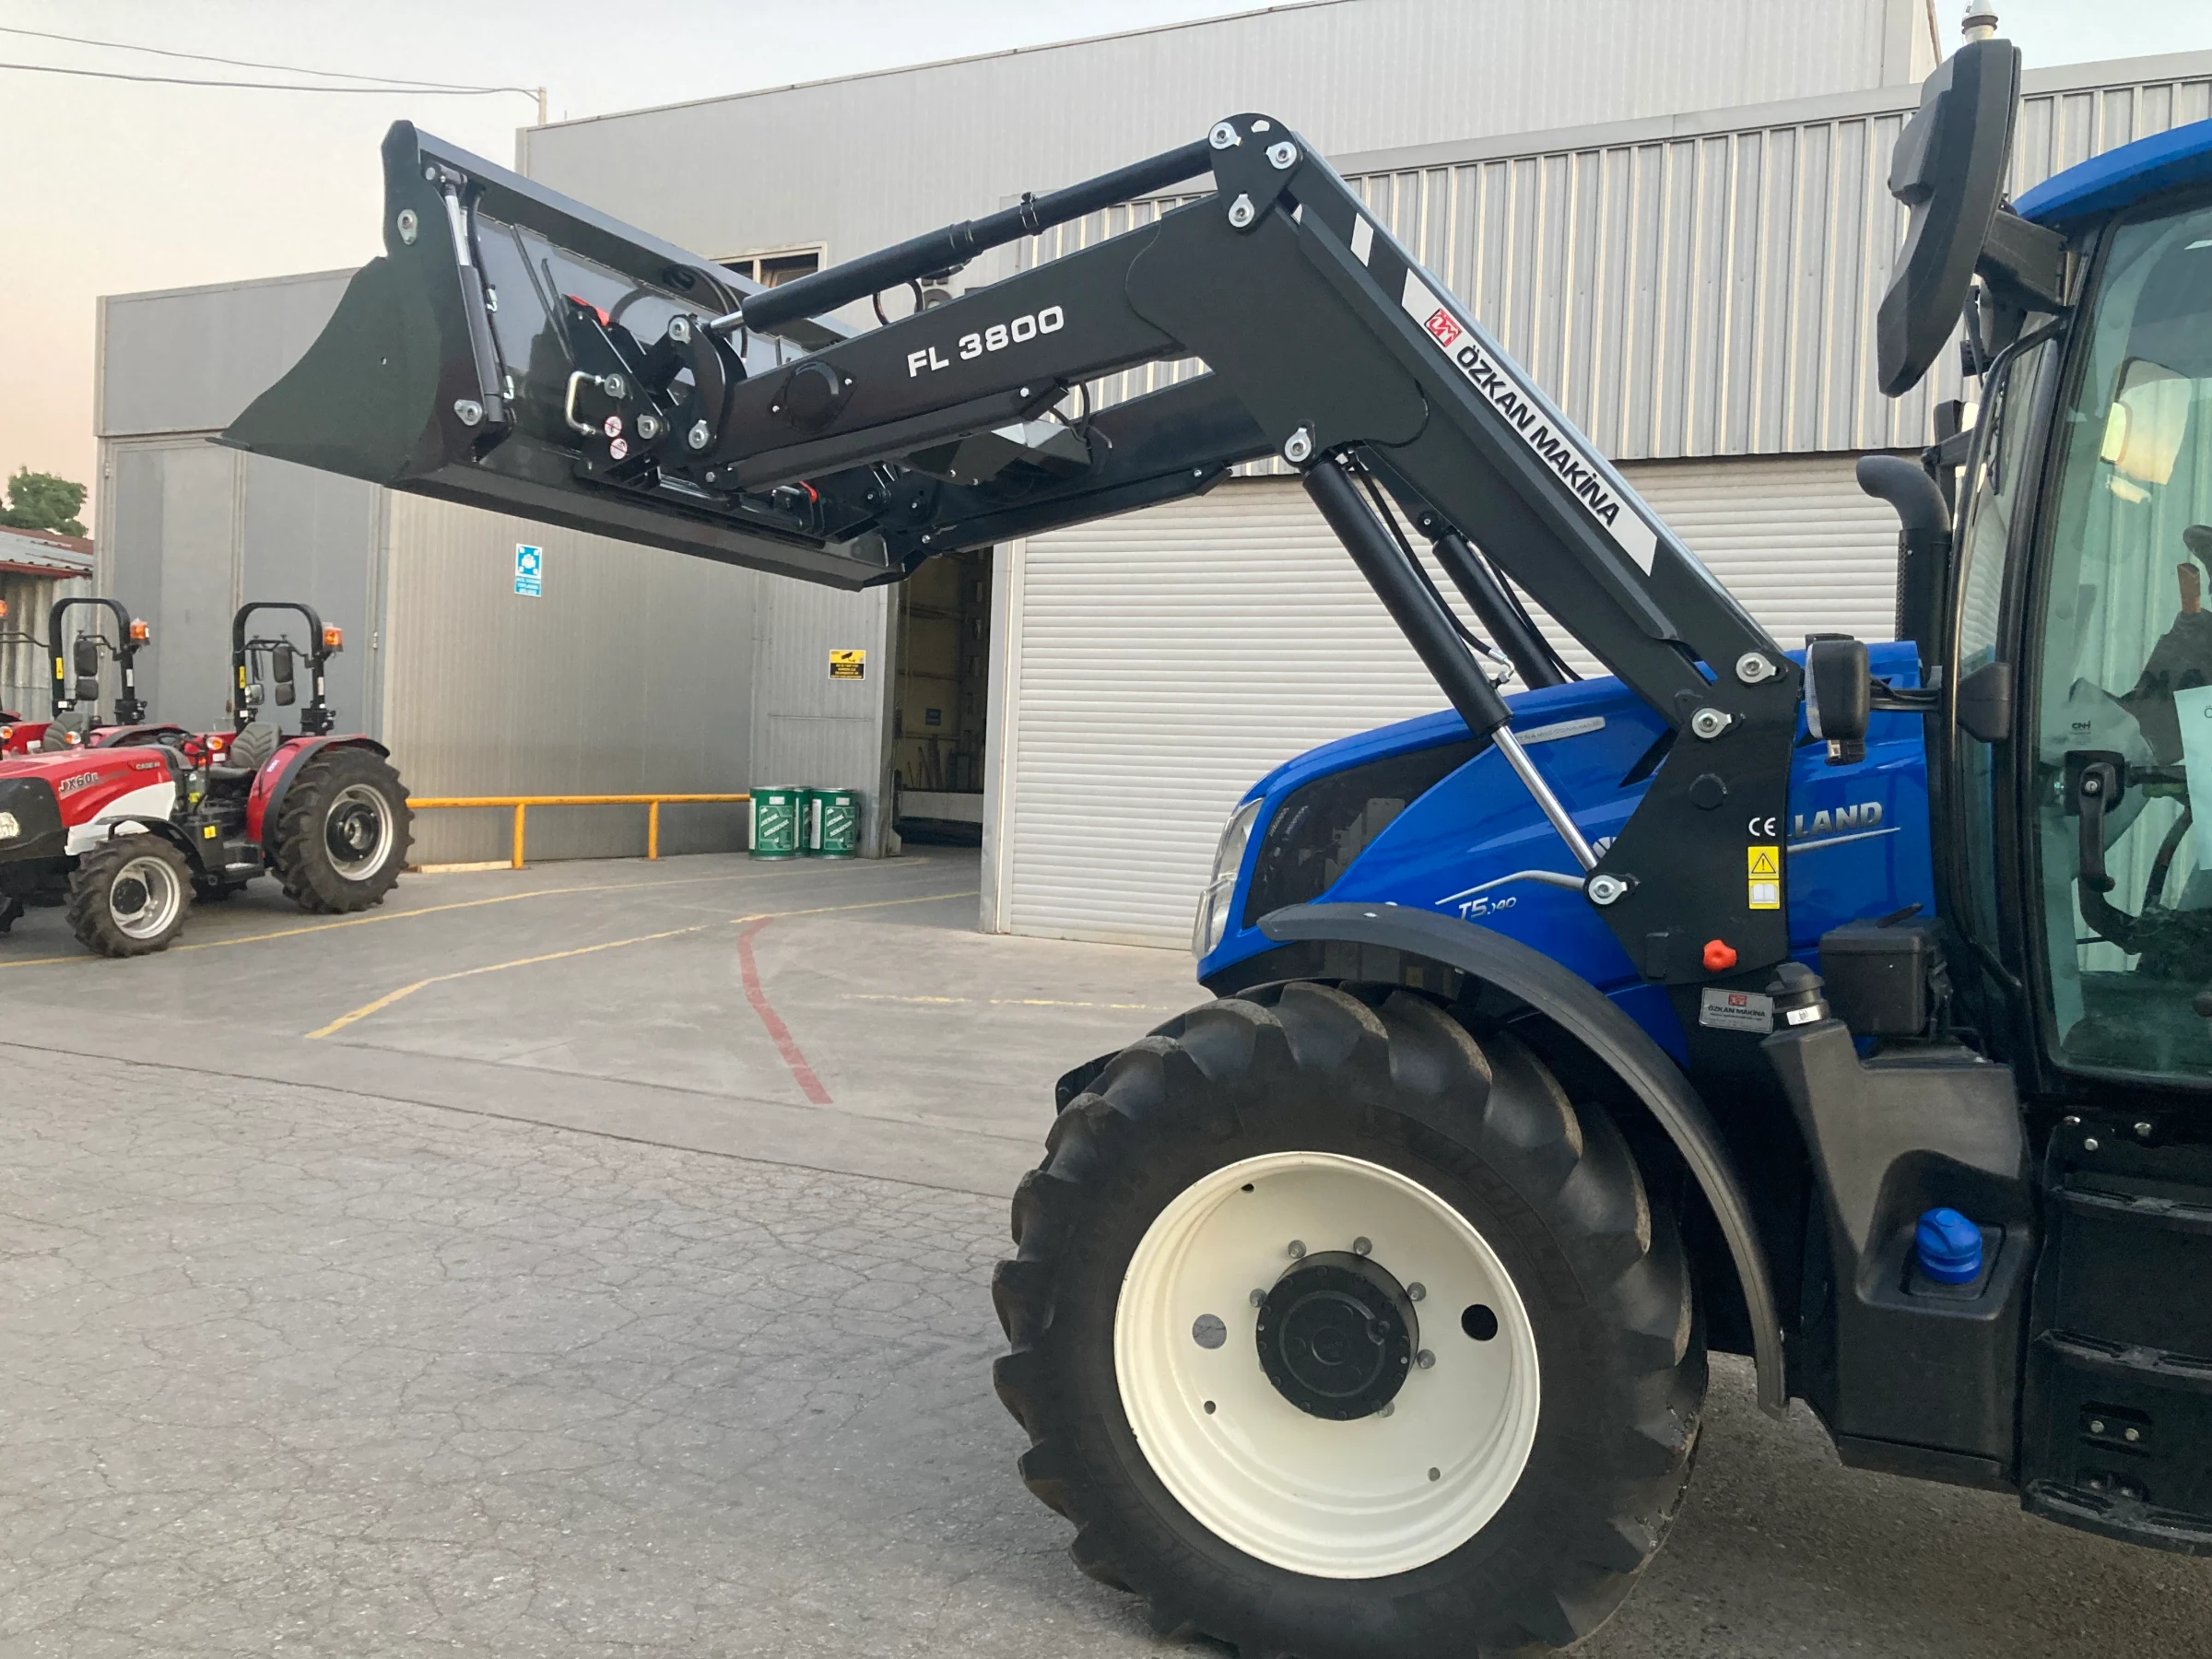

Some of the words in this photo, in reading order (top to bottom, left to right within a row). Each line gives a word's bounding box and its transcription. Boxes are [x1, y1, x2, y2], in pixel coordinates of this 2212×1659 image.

[907, 347, 949, 378] FL
[959, 305, 1065, 360] 3800
[1456, 345, 1536, 432] ÖZKAN
[1529, 425, 1620, 527] MAKİNA
[1787, 801, 1883, 839] LAND
